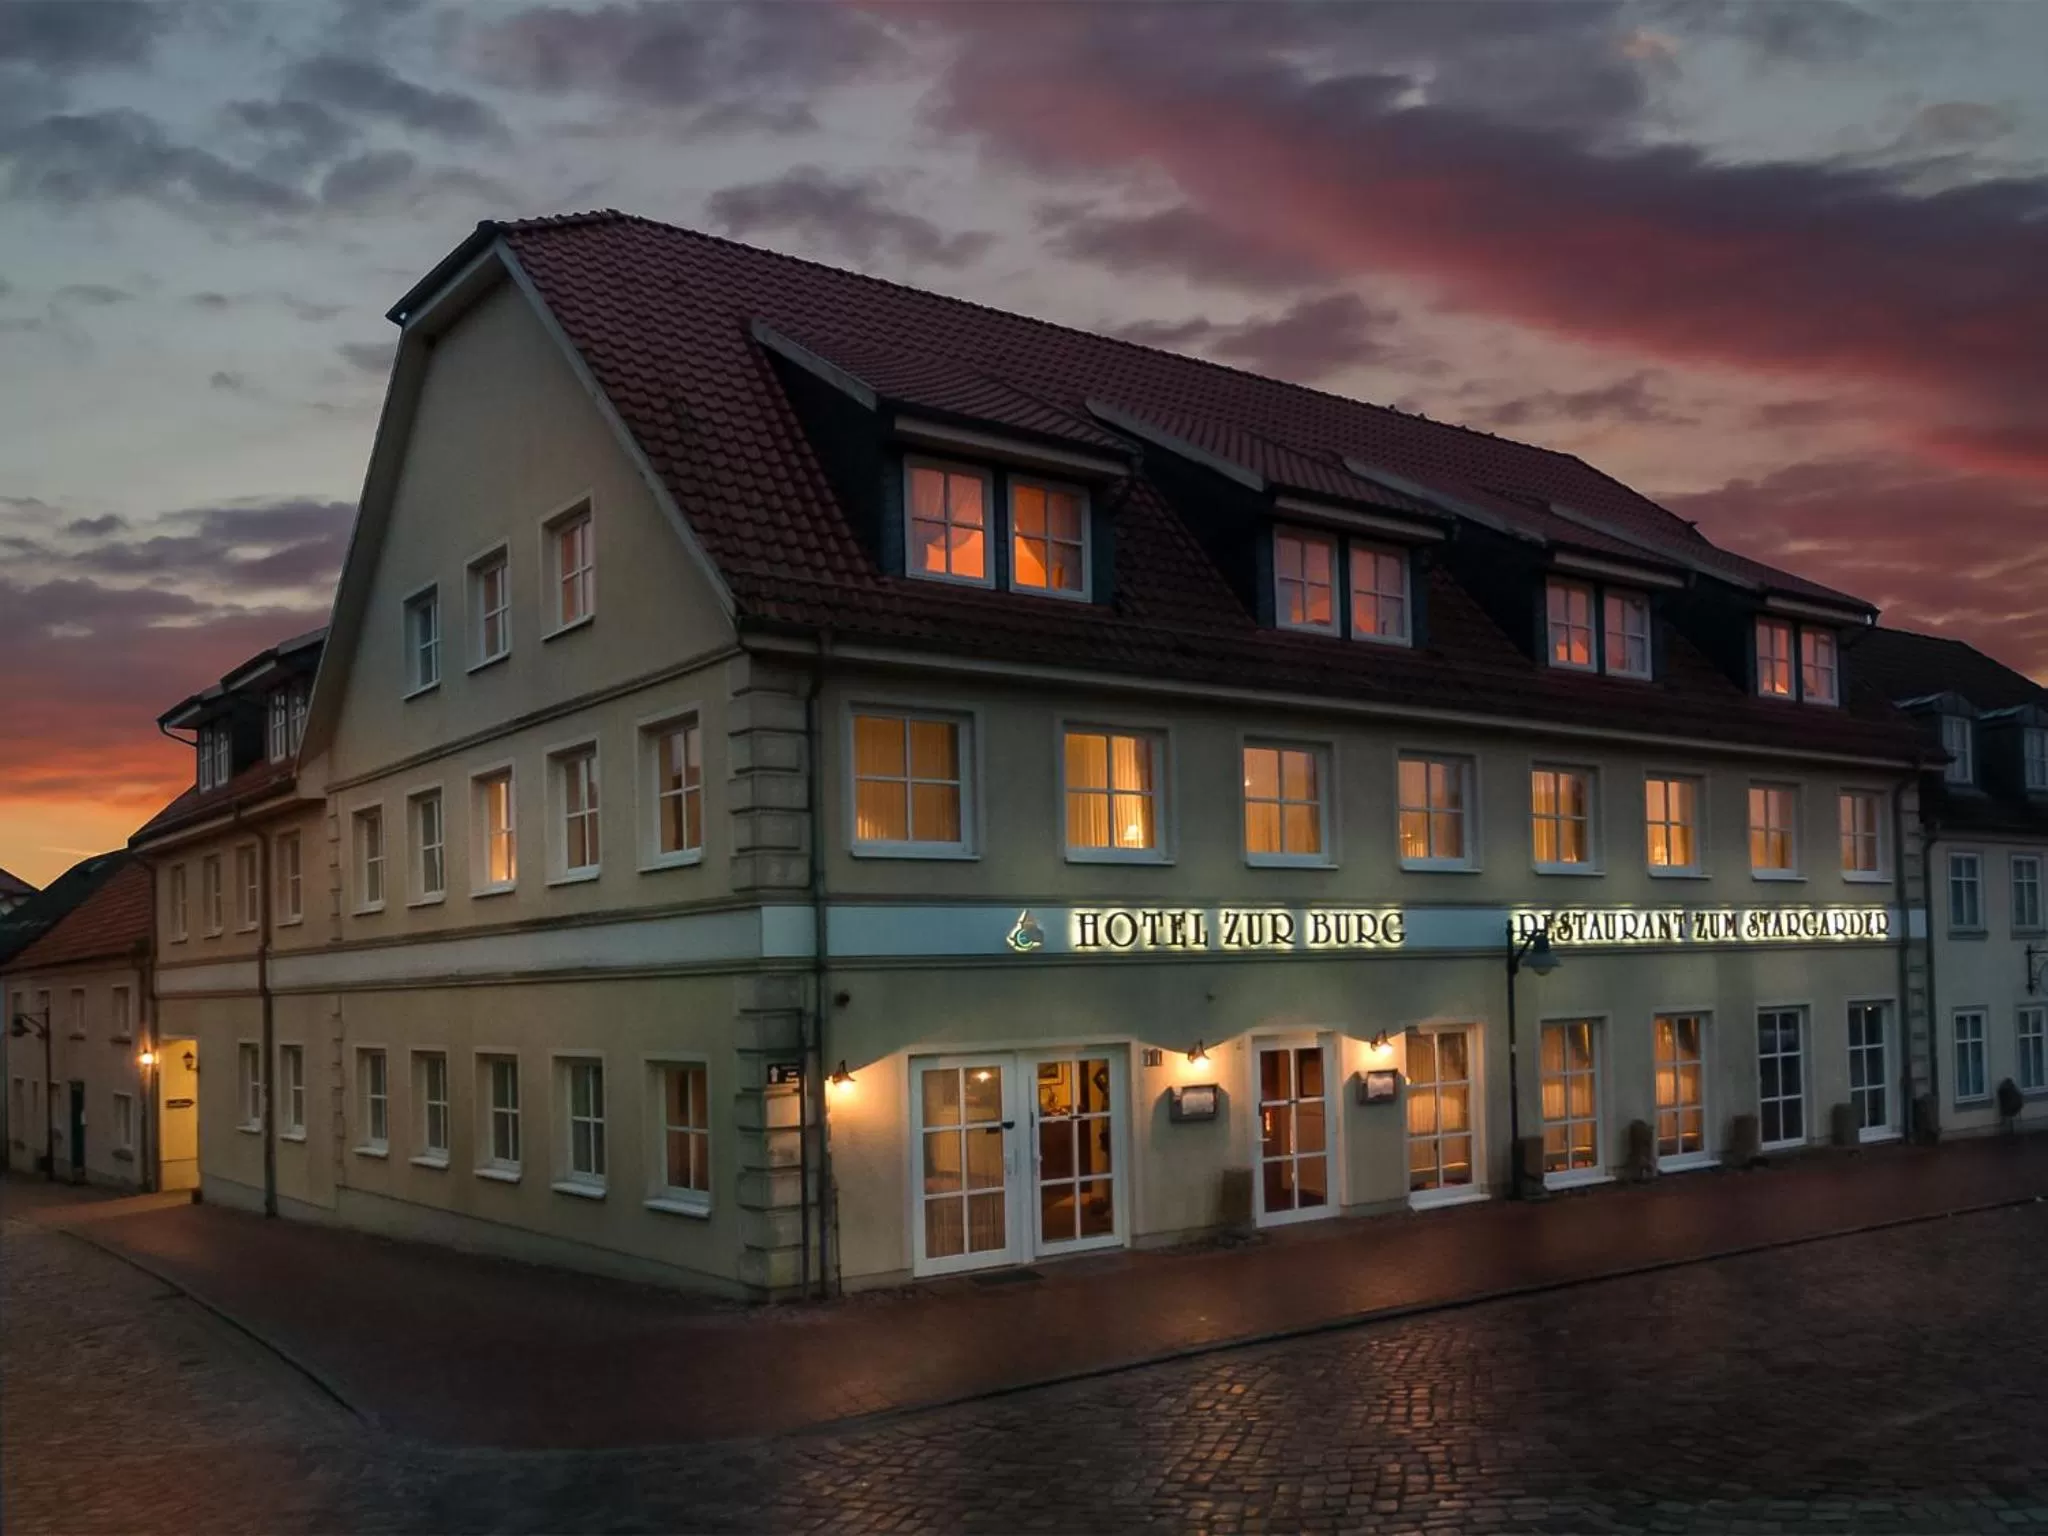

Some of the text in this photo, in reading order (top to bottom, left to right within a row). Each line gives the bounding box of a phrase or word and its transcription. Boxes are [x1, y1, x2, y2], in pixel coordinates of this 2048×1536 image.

[1075, 911, 1406, 948] HOTEL ZUR BURG
[1695, 912, 1737, 940] ZUM
[1747, 911, 1890, 937] STARGARDER
